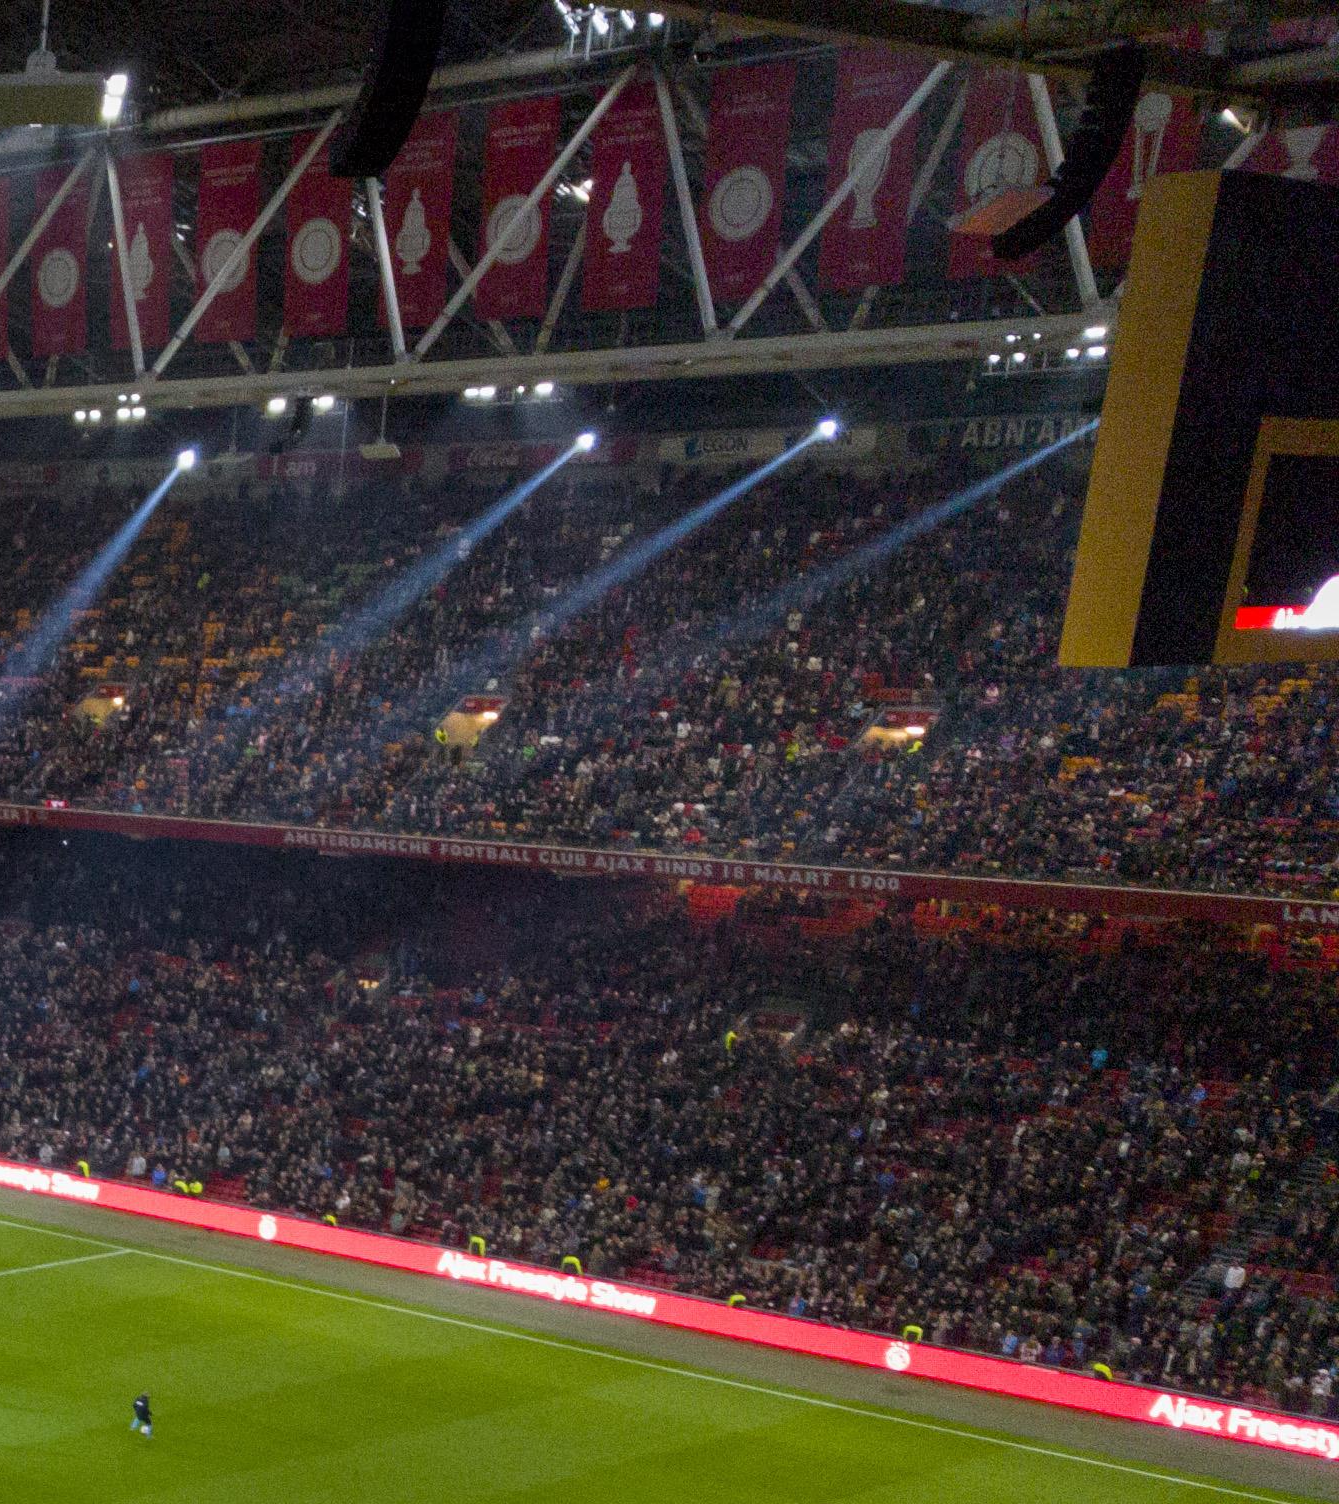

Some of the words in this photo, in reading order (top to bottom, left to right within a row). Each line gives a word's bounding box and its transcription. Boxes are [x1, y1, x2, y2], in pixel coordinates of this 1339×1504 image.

[283, 831, 430, 855] AMSTERDAMSCHE
[439, 844, 532, 864] FOOTBALL
[538, 850, 586, 867] CLUB
[594, 855, 646, 872] AJAX
[654, 861, 714, 878] SINDS
[722, 865, 745, 880] 18
[754, 868, 833, 887] MAART
[848, 874, 900, 892] 1900
[50, 1172, 100, 1200] Show
[437, 1251, 487, 1281] Ajax
[489, 1260, 588, 1301] Freestyle
[590, 1282, 657, 1316] Show
[1149, 1394, 1222, 1428] Ajax
